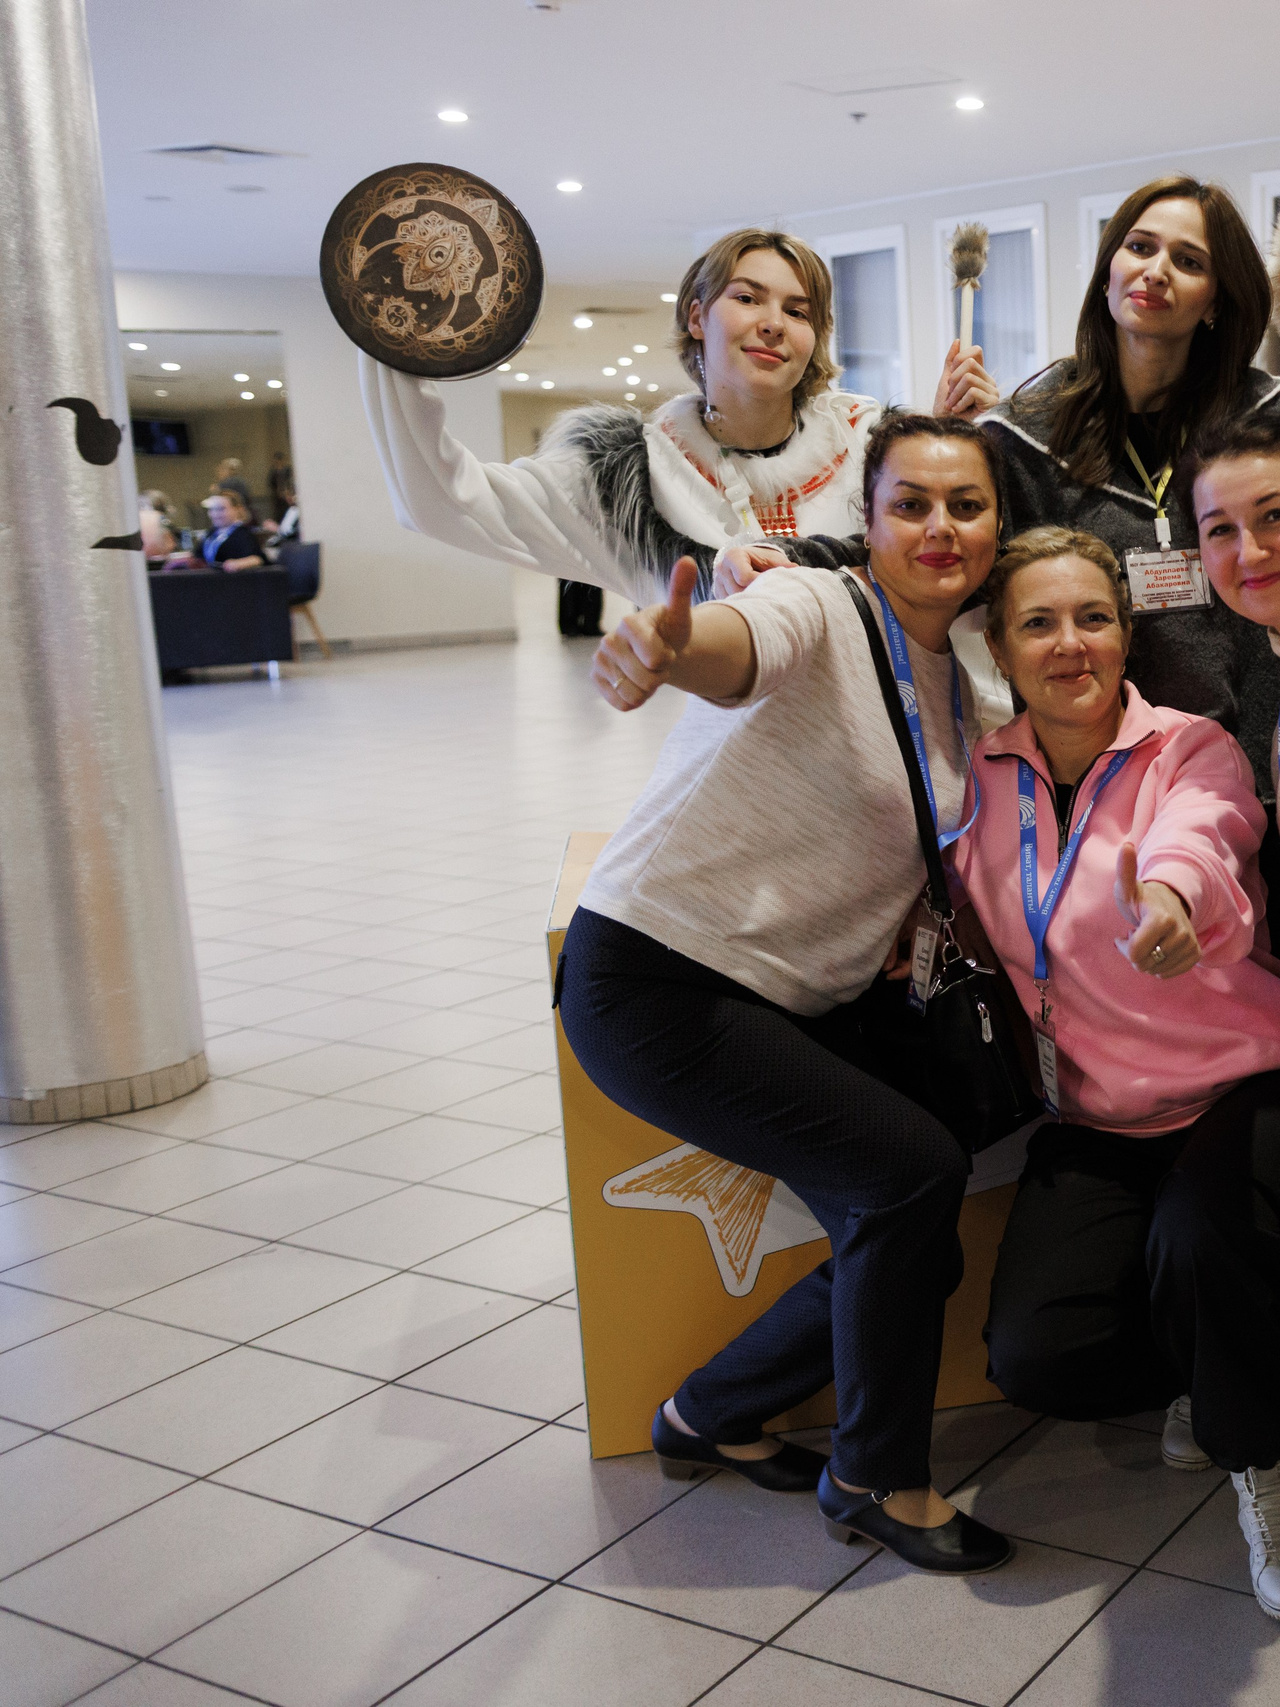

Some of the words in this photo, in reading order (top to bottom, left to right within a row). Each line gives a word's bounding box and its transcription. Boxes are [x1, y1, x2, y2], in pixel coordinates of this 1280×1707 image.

[890, 623, 907, 665] таланты!
[1025, 843, 1033, 871] Виват,
[1027, 872, 1036, 914] таланты!
[1041, 888, 1057, 915] Виват,
[1054, 846, 1073, 886] таланты!
